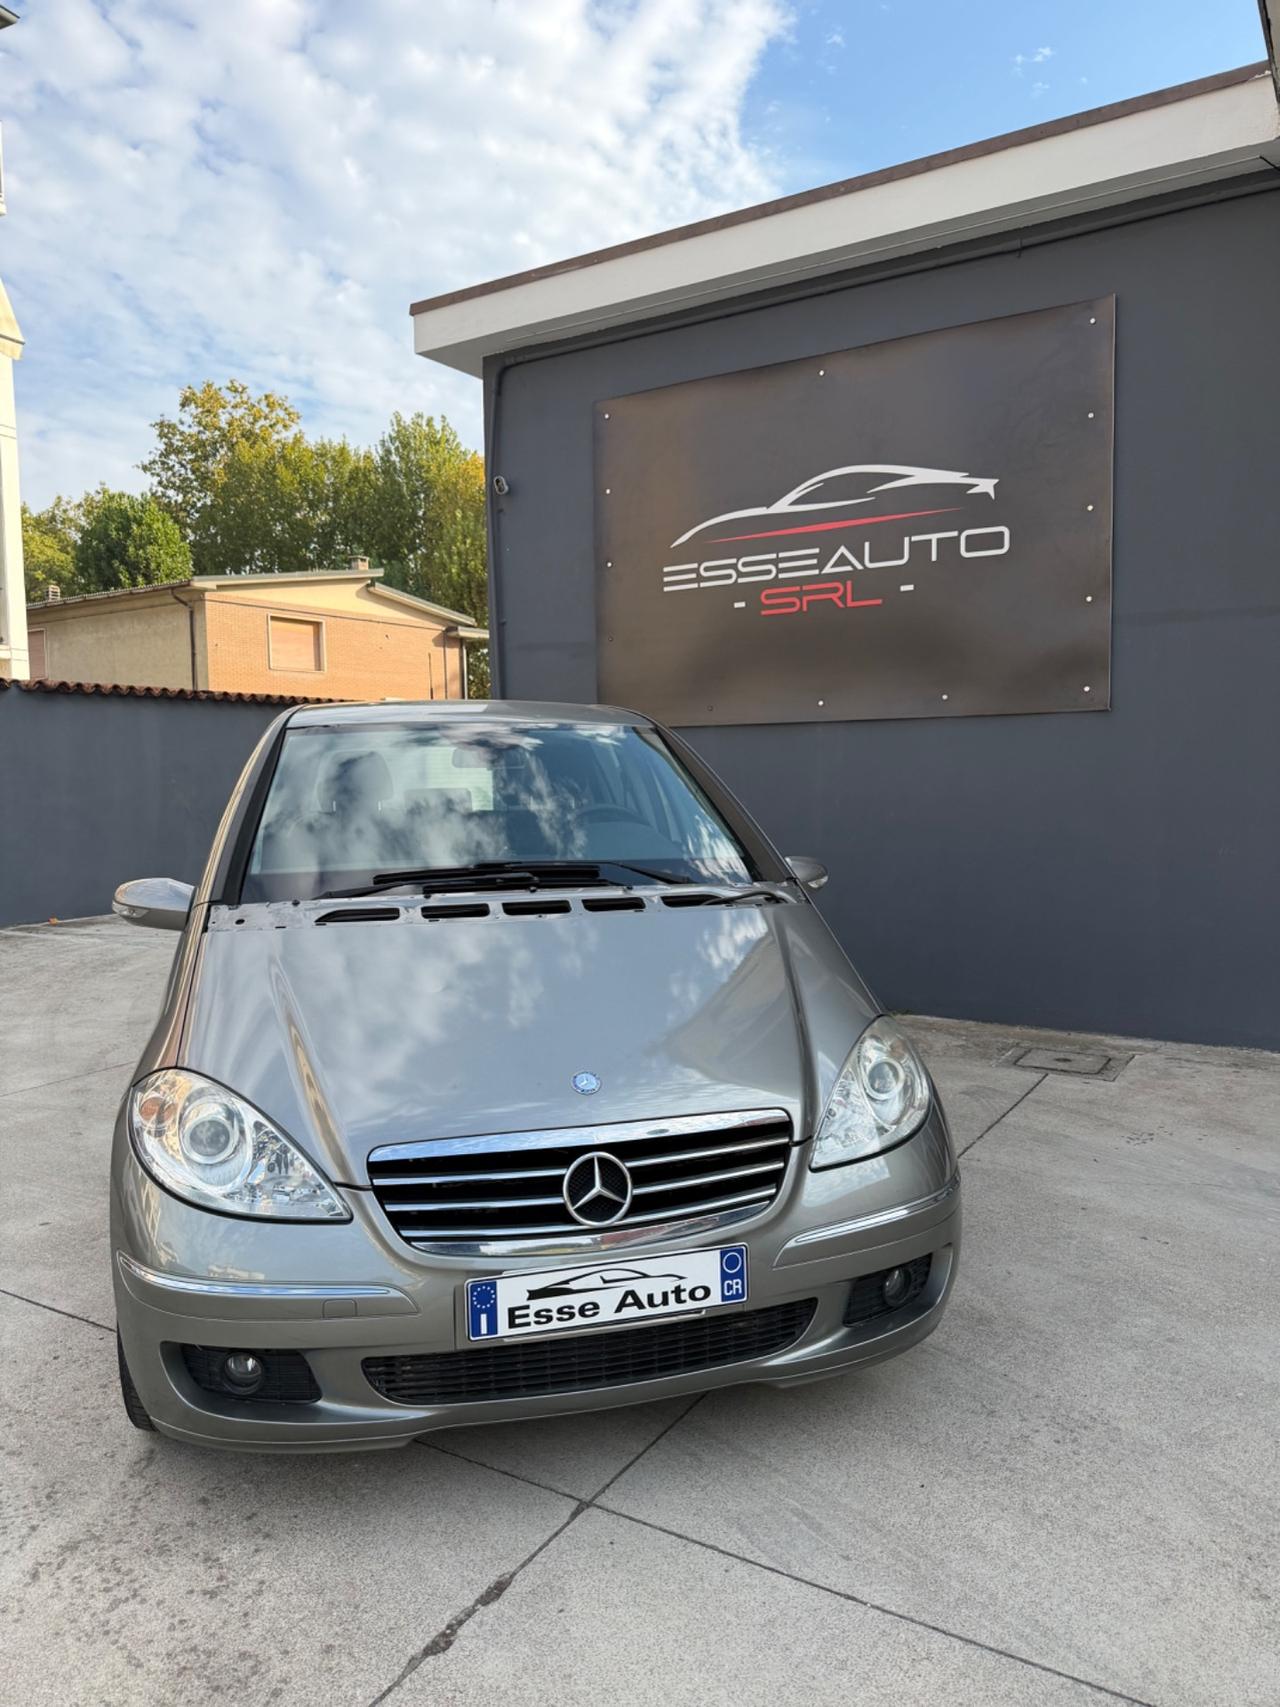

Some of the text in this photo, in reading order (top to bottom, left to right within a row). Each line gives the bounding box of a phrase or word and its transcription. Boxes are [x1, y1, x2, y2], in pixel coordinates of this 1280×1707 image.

[663, 525, 1010, 592] ESSEAUTO
[760, 580, 883, 616] SRL
[724, 1279, 742, 1296] CR
[480, 1313, 487, 1334] I
[507, 1284, 711, 1329] Esse Auto
